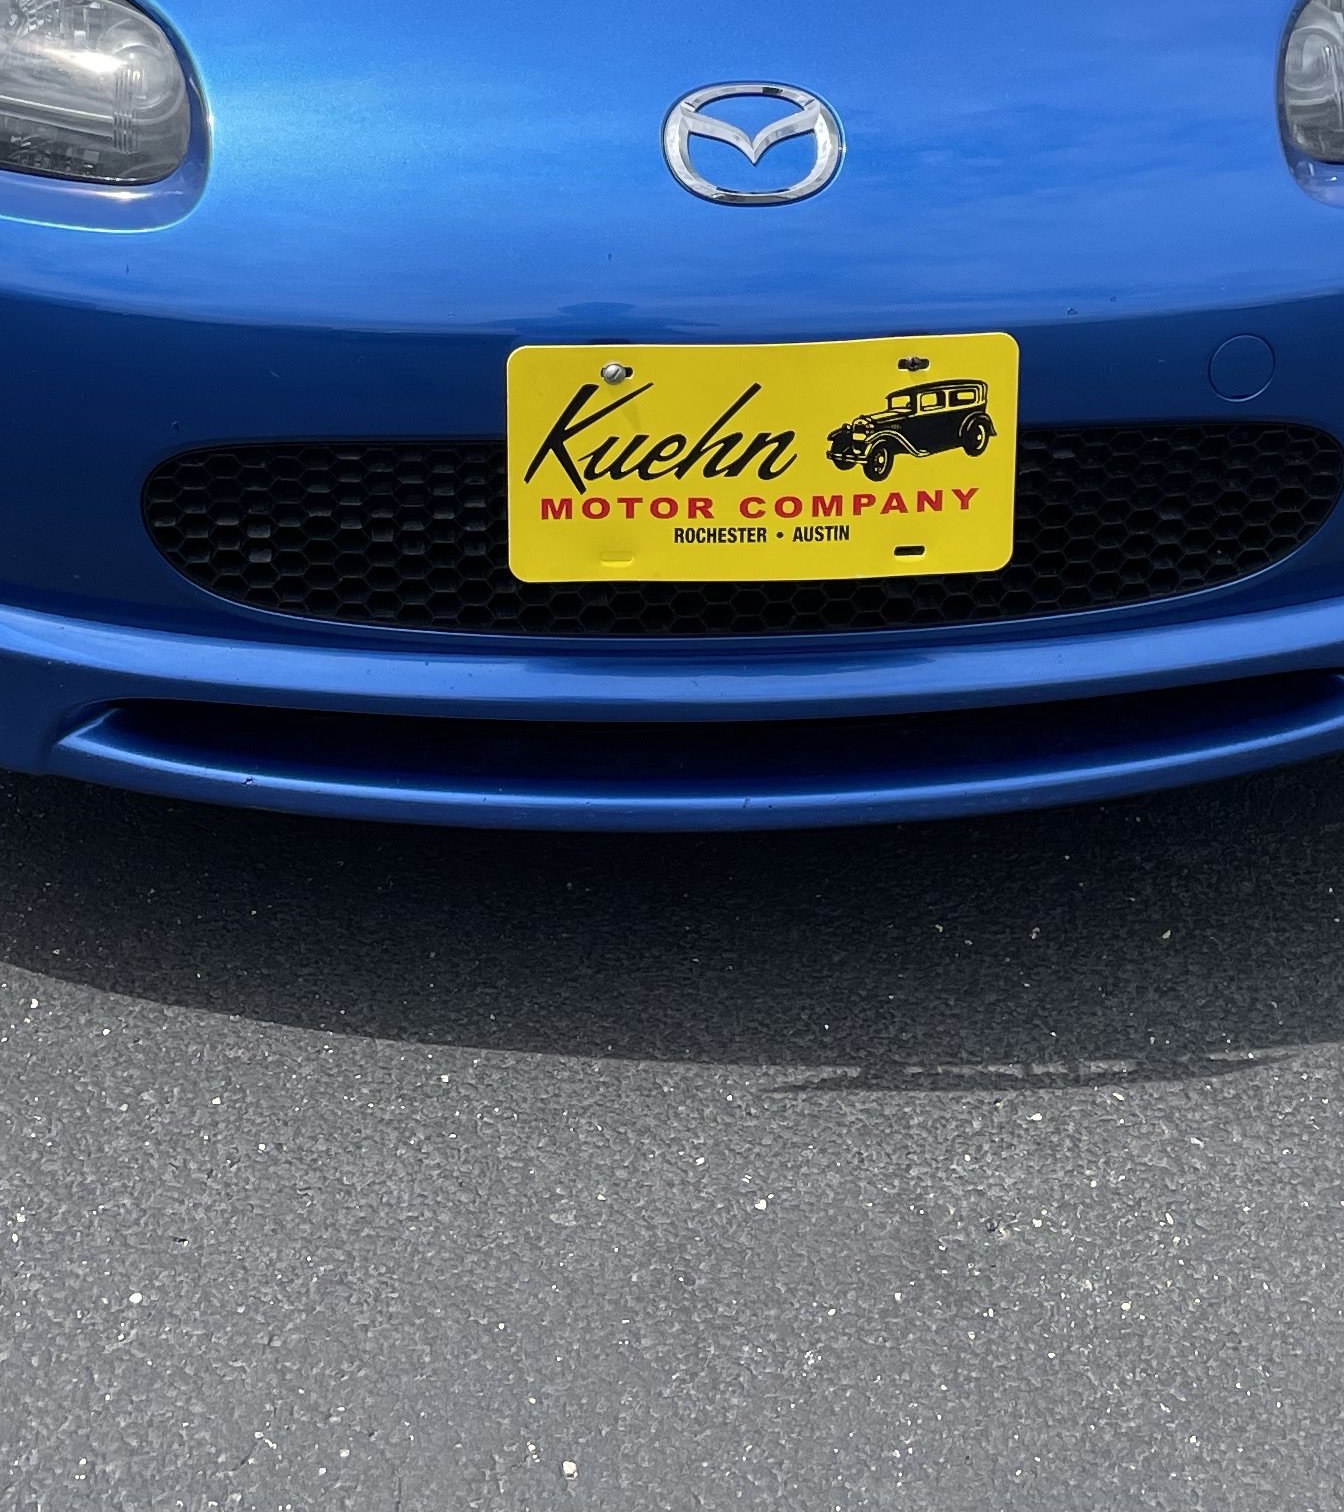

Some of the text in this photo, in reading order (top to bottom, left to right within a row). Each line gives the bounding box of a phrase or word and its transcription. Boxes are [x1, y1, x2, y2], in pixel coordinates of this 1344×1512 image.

[523, 381, 797, 495] Kuehn
[540, 487, 981, 521] MOTOR COMPANY
[673, 524, 850, 544] ROCHESTER AUSTIN
